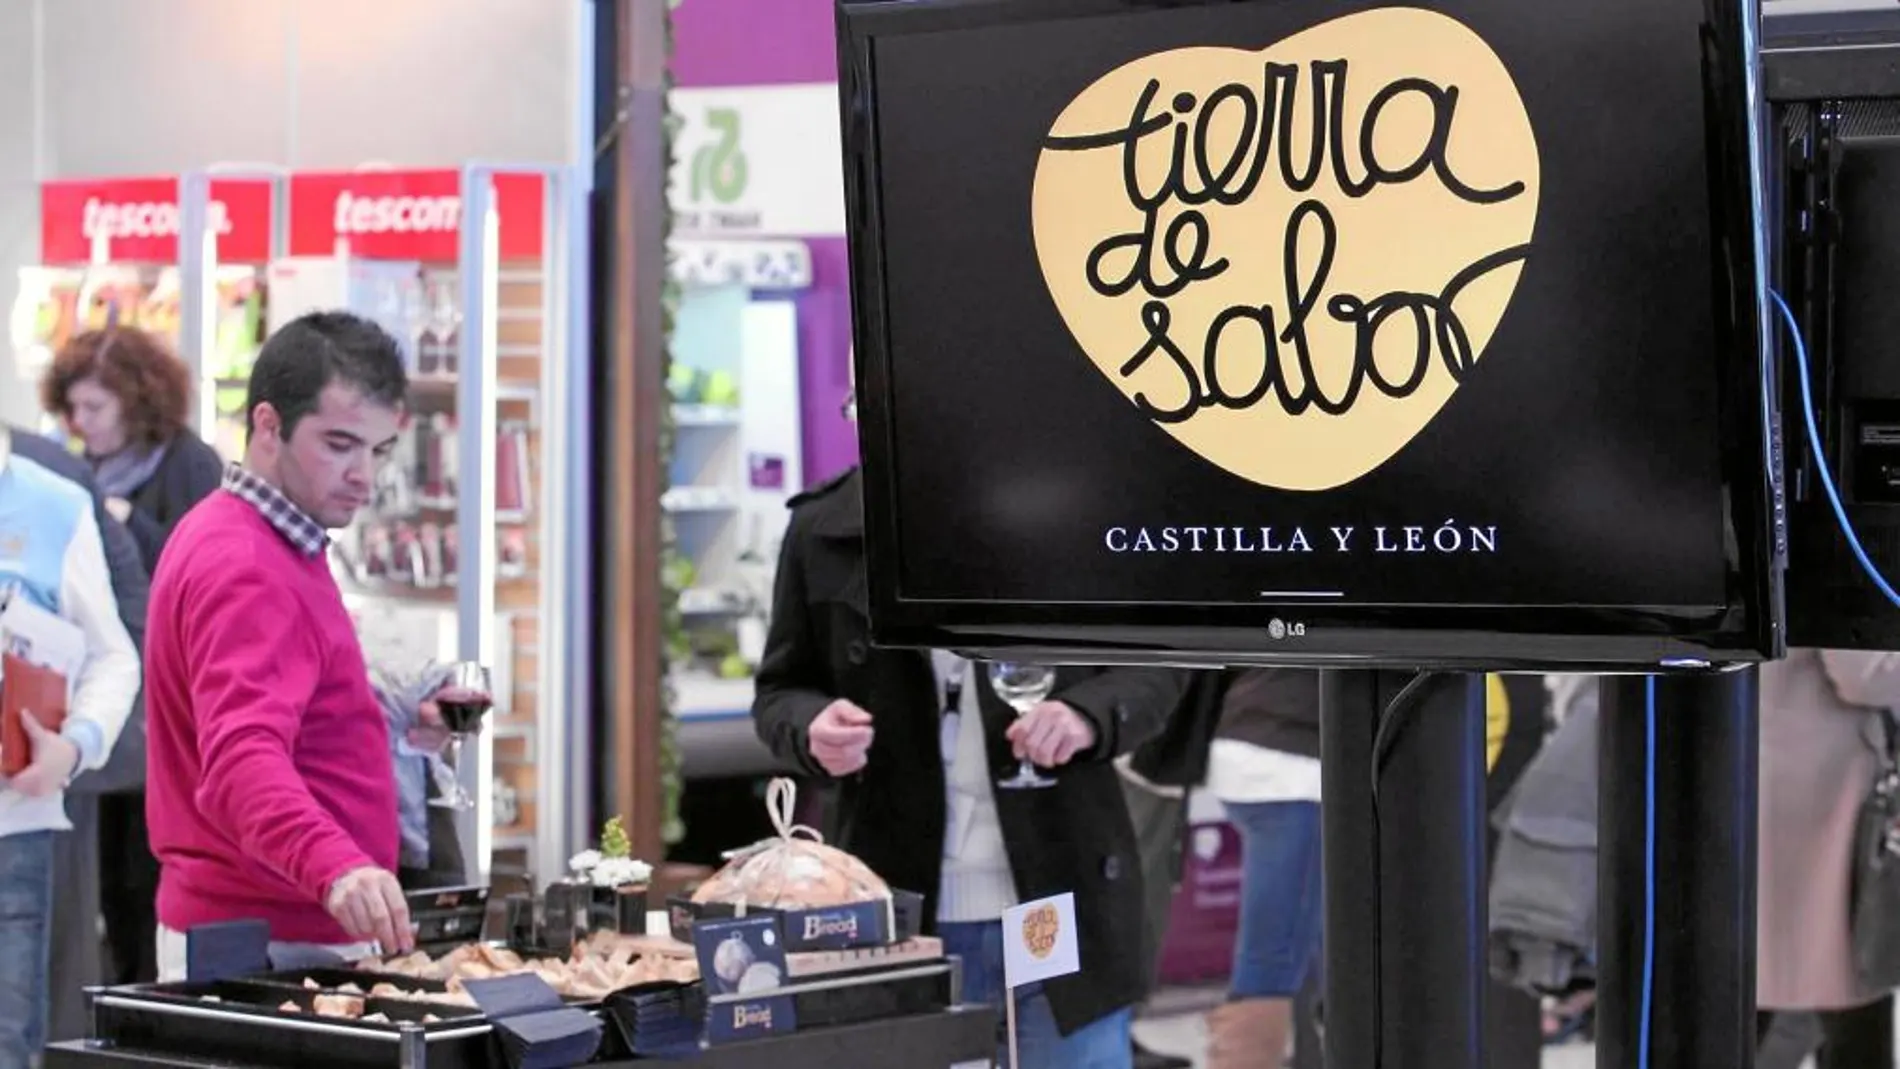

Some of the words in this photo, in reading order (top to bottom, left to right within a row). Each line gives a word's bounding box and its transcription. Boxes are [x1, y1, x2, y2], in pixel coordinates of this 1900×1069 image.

[1043, 58, 1525, 211] tierra
[334, 190, 462, 233] tescom
[1086, 208, 1229, 299] de
[1119, 199, 1535, 424] sabor
[1105, 526, 1313, 552] CASTILLA
[1330, 527, 1354, 551] Y
[1374, 518, 1498, 552] LEÓN
[1286, 622, 1306, 637] LG
[803, 914, 858, 940] Bread
